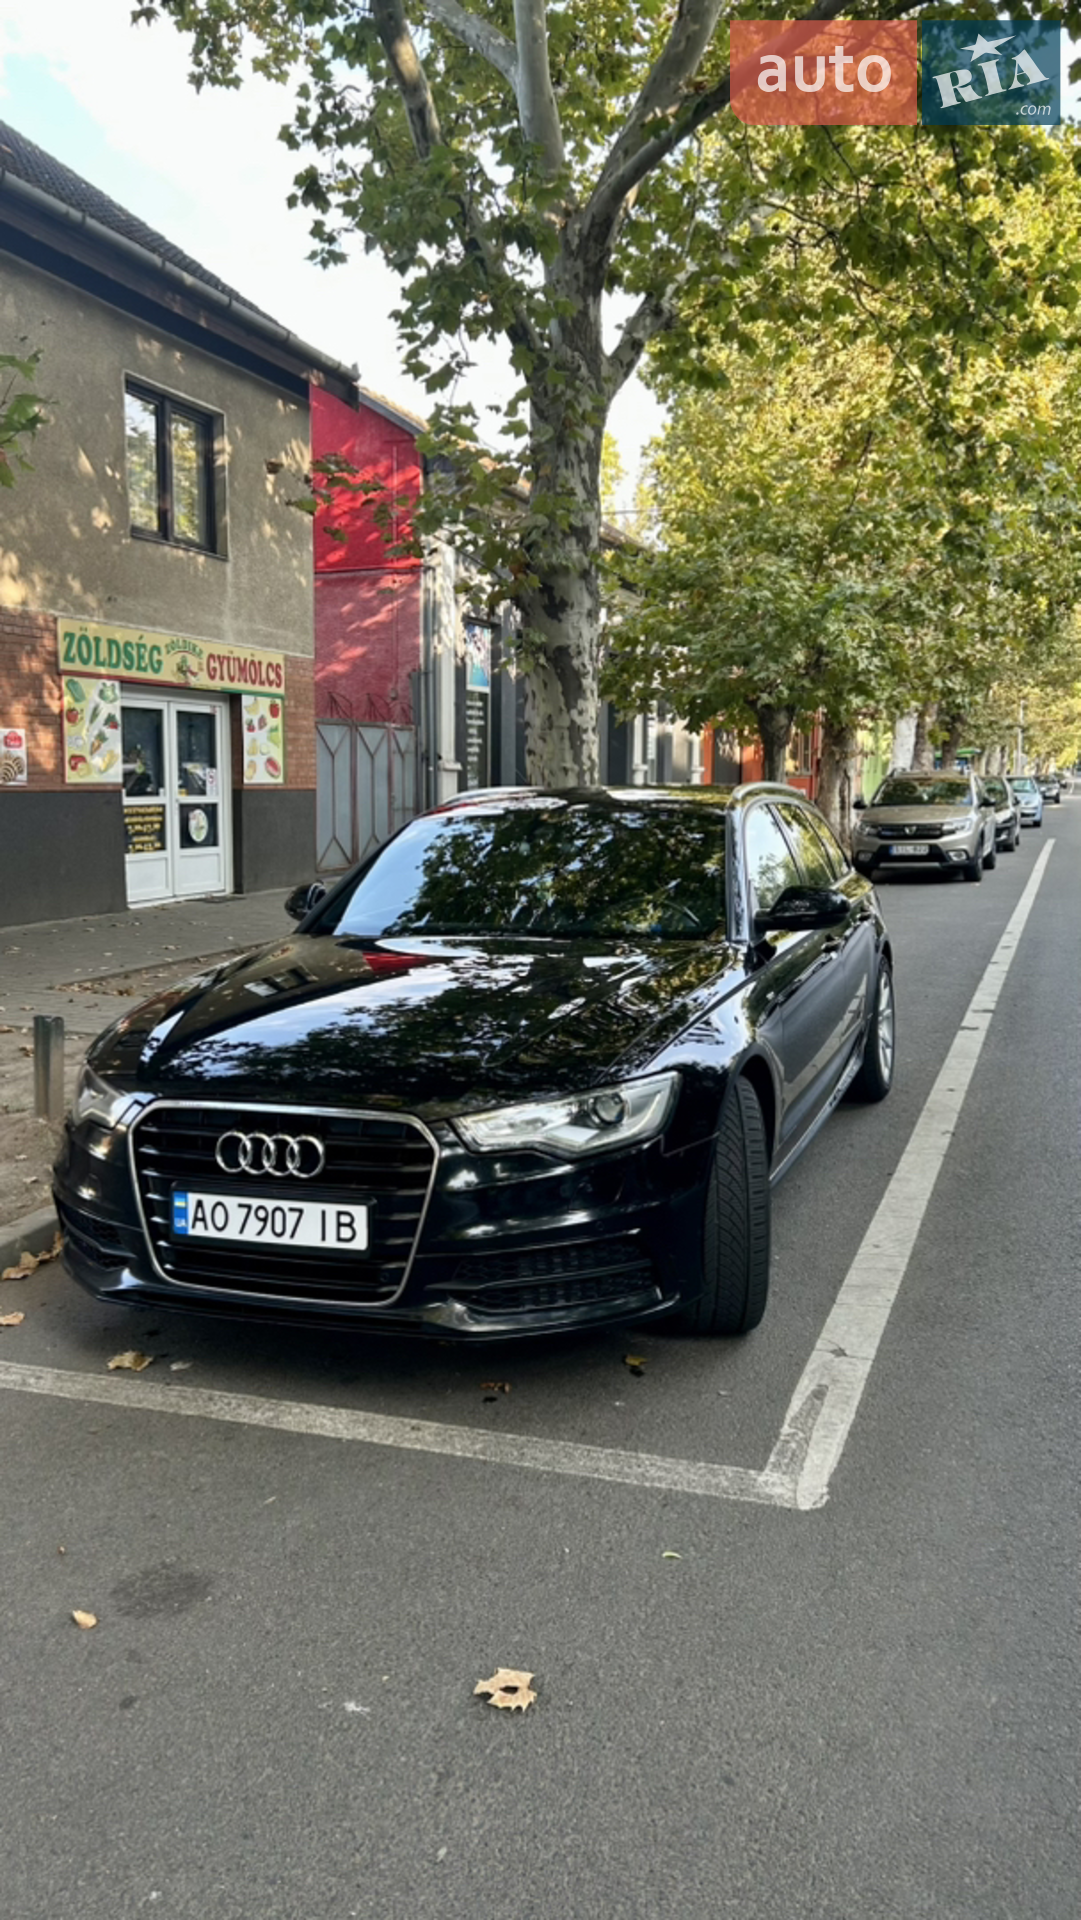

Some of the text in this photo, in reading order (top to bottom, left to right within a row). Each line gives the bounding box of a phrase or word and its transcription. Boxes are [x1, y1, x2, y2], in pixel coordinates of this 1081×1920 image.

[63, 626, 164, 675] ZÖLDSÉG
[206, 650, 283, 688] GYÜMÖLCS
[191, 1198, 357, 1243] AO 7907 IB
